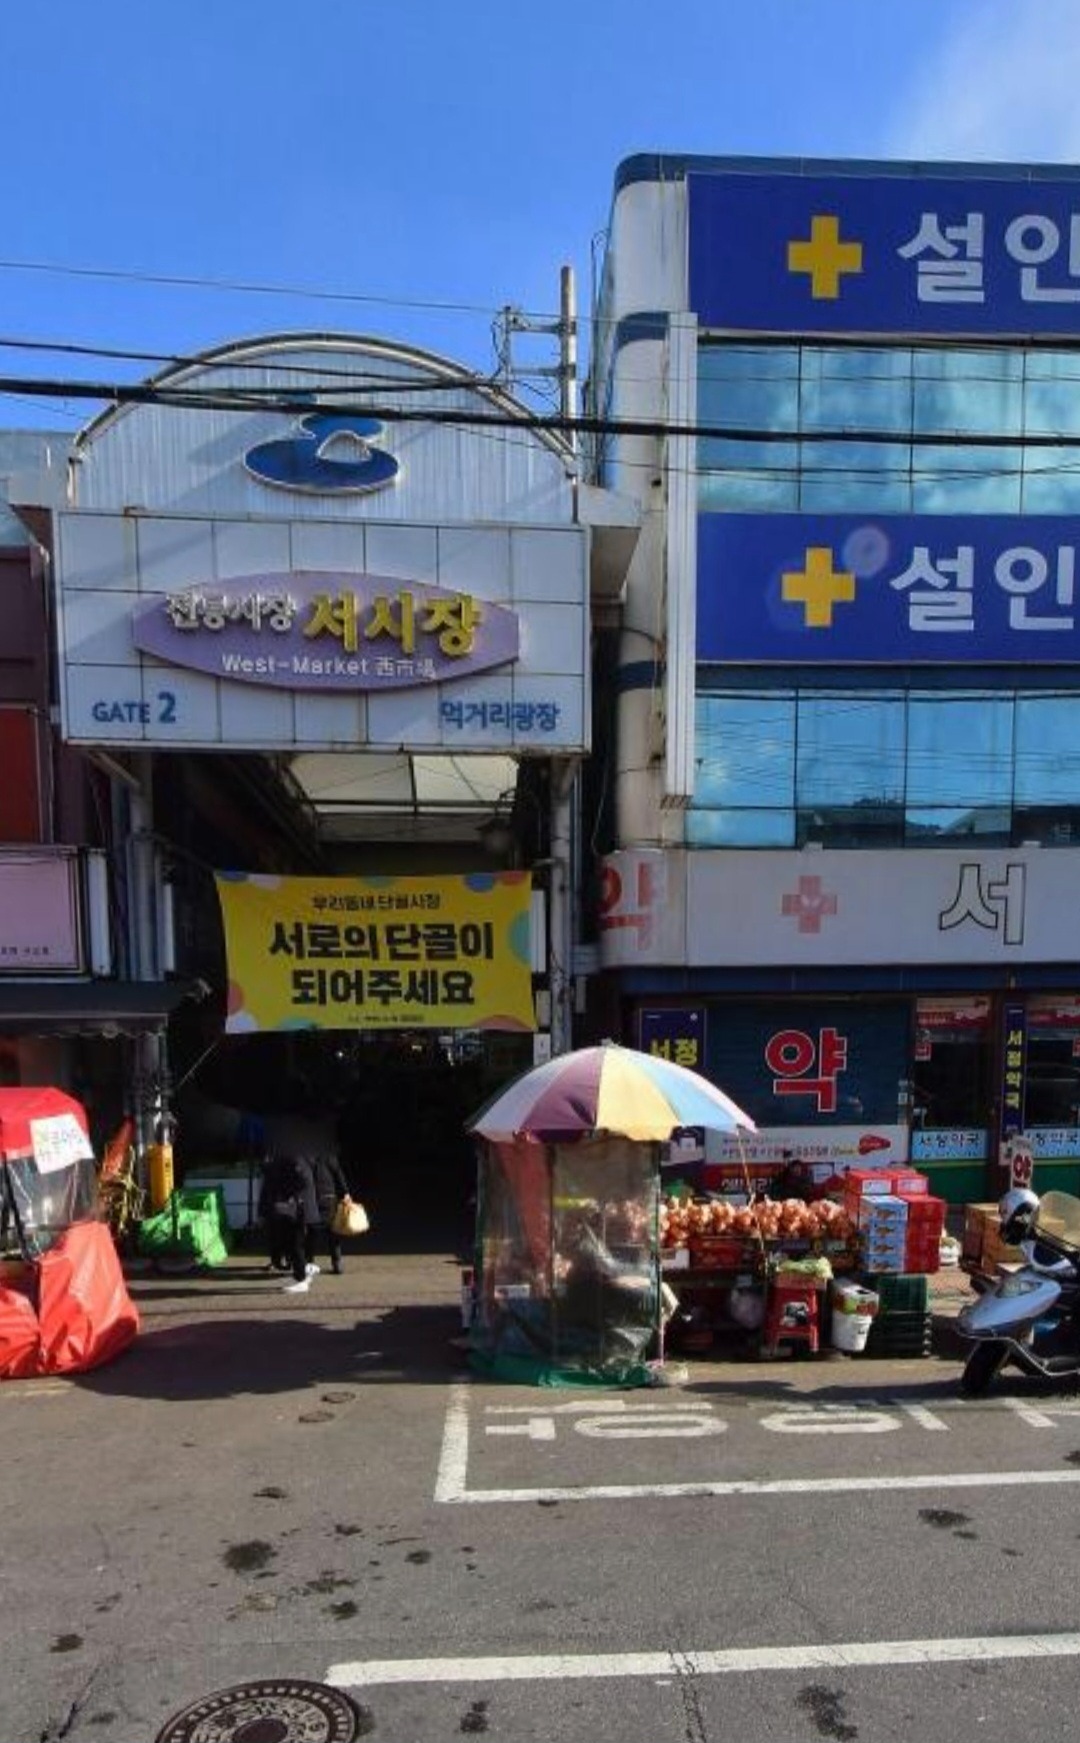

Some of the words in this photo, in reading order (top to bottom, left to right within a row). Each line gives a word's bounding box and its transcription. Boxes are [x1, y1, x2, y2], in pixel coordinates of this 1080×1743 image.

[889, 545, 1075, 632] 설인
[304, 590, 482, 657] 서시장
[222, 653, 368, 676] West-Market
[92, 702, 151, 723] GATE
[157, 692, 177, 724] 2
[440, 699, 561, 731] 먹거리광장
[938, 863, 1027, 945] 서
[270, 922, 379, 960] 서로의
[385, 921, 494, 960] 단골이
[291, 968, 475, 1006] 되어주세요
[765, 1027, 848, 1113] 약
